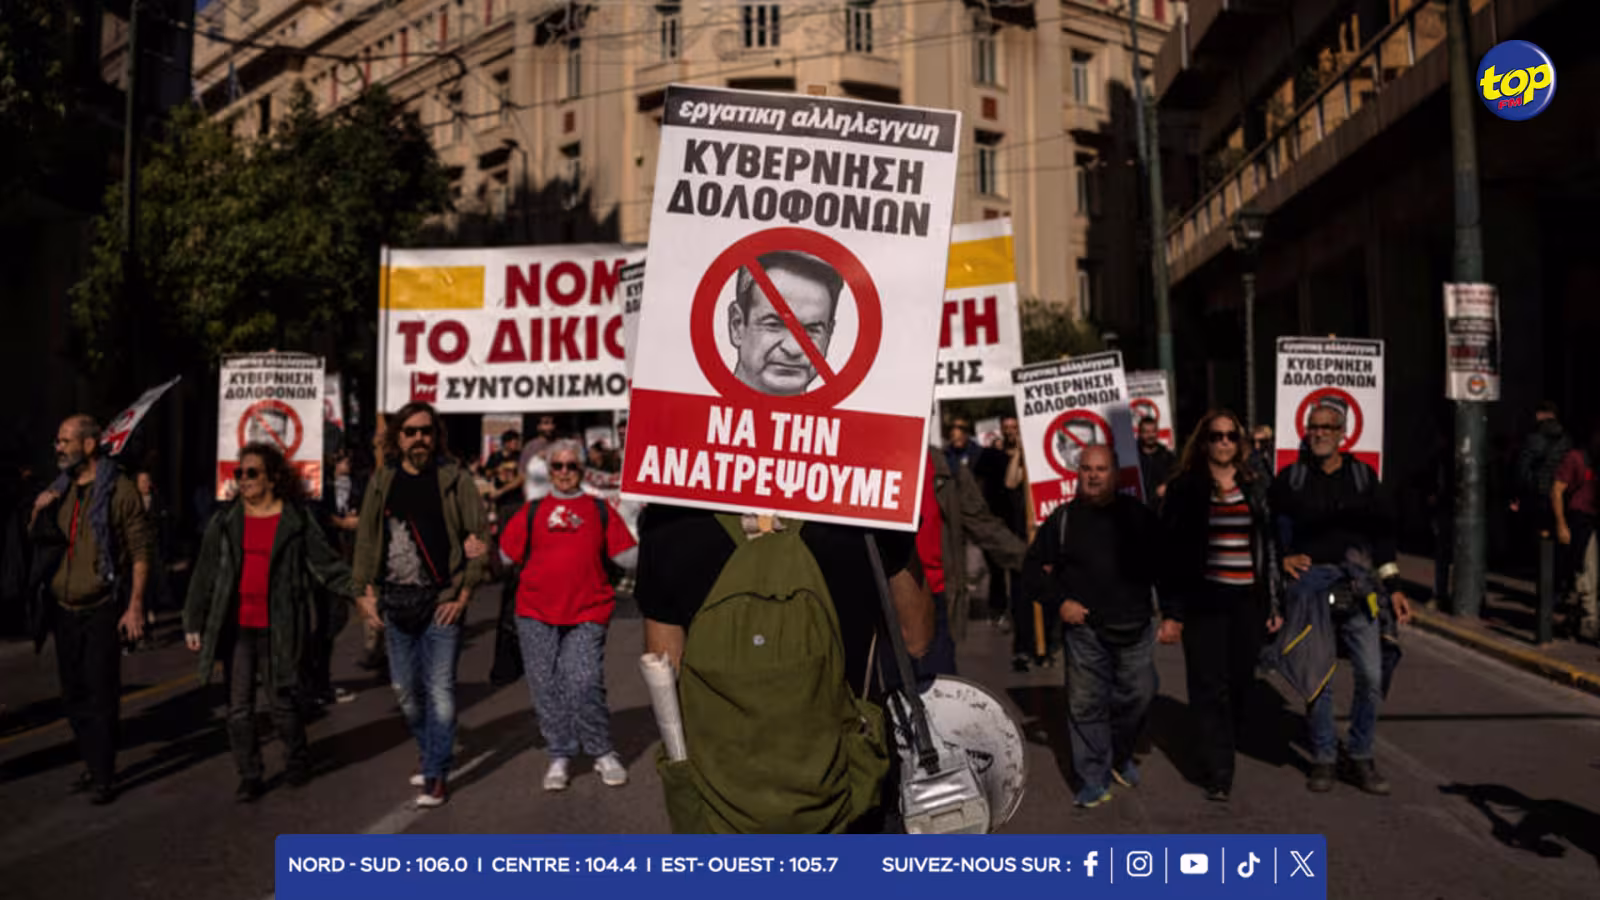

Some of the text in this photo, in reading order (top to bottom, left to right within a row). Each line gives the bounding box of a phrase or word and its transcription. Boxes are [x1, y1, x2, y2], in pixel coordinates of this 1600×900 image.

[679, 100, 940, 146] εργατικη αλληλεγγυη
[683, 138, 924, 195] ΚΥΒΕΡΝΗΣΗ
[666, 179, 931, 237] ΔΟΛΟΦΟΝΩΝ
[397, 319, 470, 365] ΤΟ
[1287, 357, 1372, 373] ΚΥΒΕΡΝΗΣΗ
[1024, 373, 1114, 400] ΚΥΒΕΡΝΗΣΗ
[1024, 388, 1120, 416] ΔΟΛΟΦΟΝΩΝ
[1283, 373, 1376, 388] ΔΟΛΟΦΟΝΩΝ
[706, 405, 841, 456] ΝΑ ΤΗΝ
[636, 445, 903, 510] ΑΝΑΤΡΕΨΟΥΜΕ
